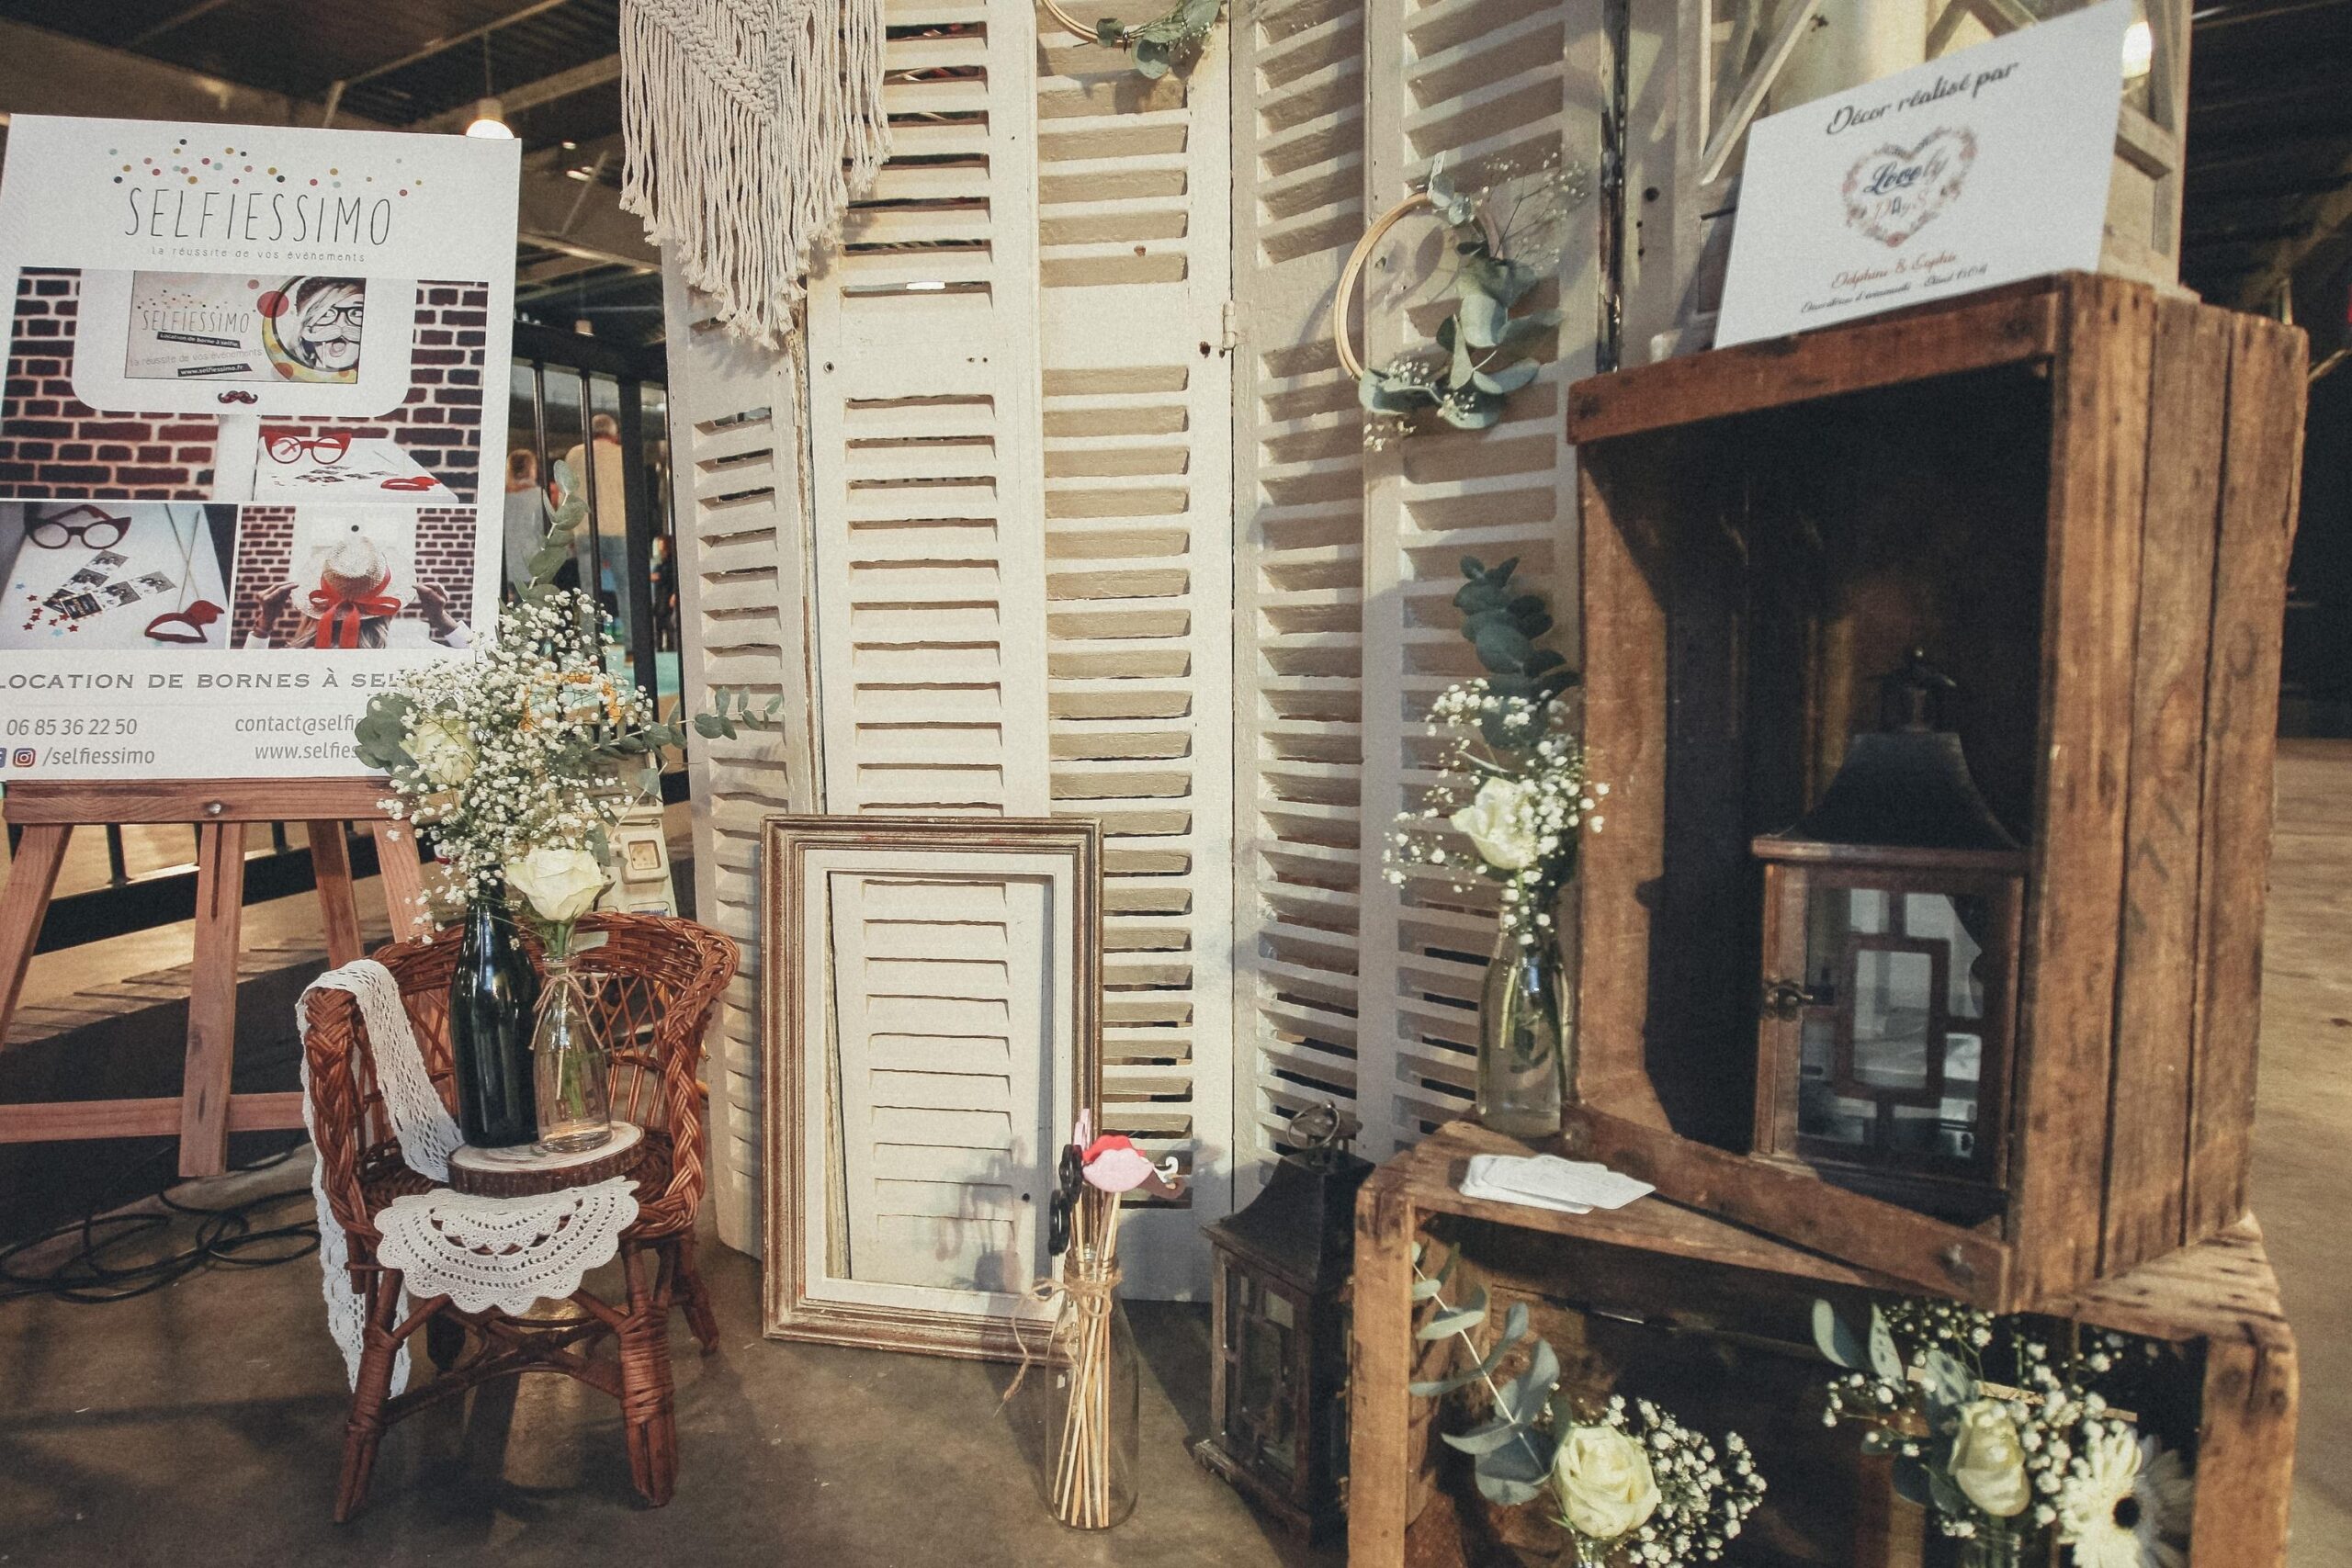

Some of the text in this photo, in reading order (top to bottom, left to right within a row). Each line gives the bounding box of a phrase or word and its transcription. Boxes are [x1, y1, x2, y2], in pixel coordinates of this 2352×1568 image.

[1826, 62, 2019, 135] Décor réalisé par
[125, 187, 390, 246] SELFIESSIMO
[172, 247, 228, 257] réussite
[235, 249, 249, 258] de
[257, 251, 279, 259] vos
[1894, 258, 1906, 275] &
[142, 310, 250, 333] SELFIESSIMO
[180, 365, 243, 376] www.selfiessimo.fr
[0, 667, 399, 689] OCATION DE BORNES À SEL
[6, 718, 138, 736] 06 85 36 22 50
[42, 747, 155, 767] /selfiessimo
